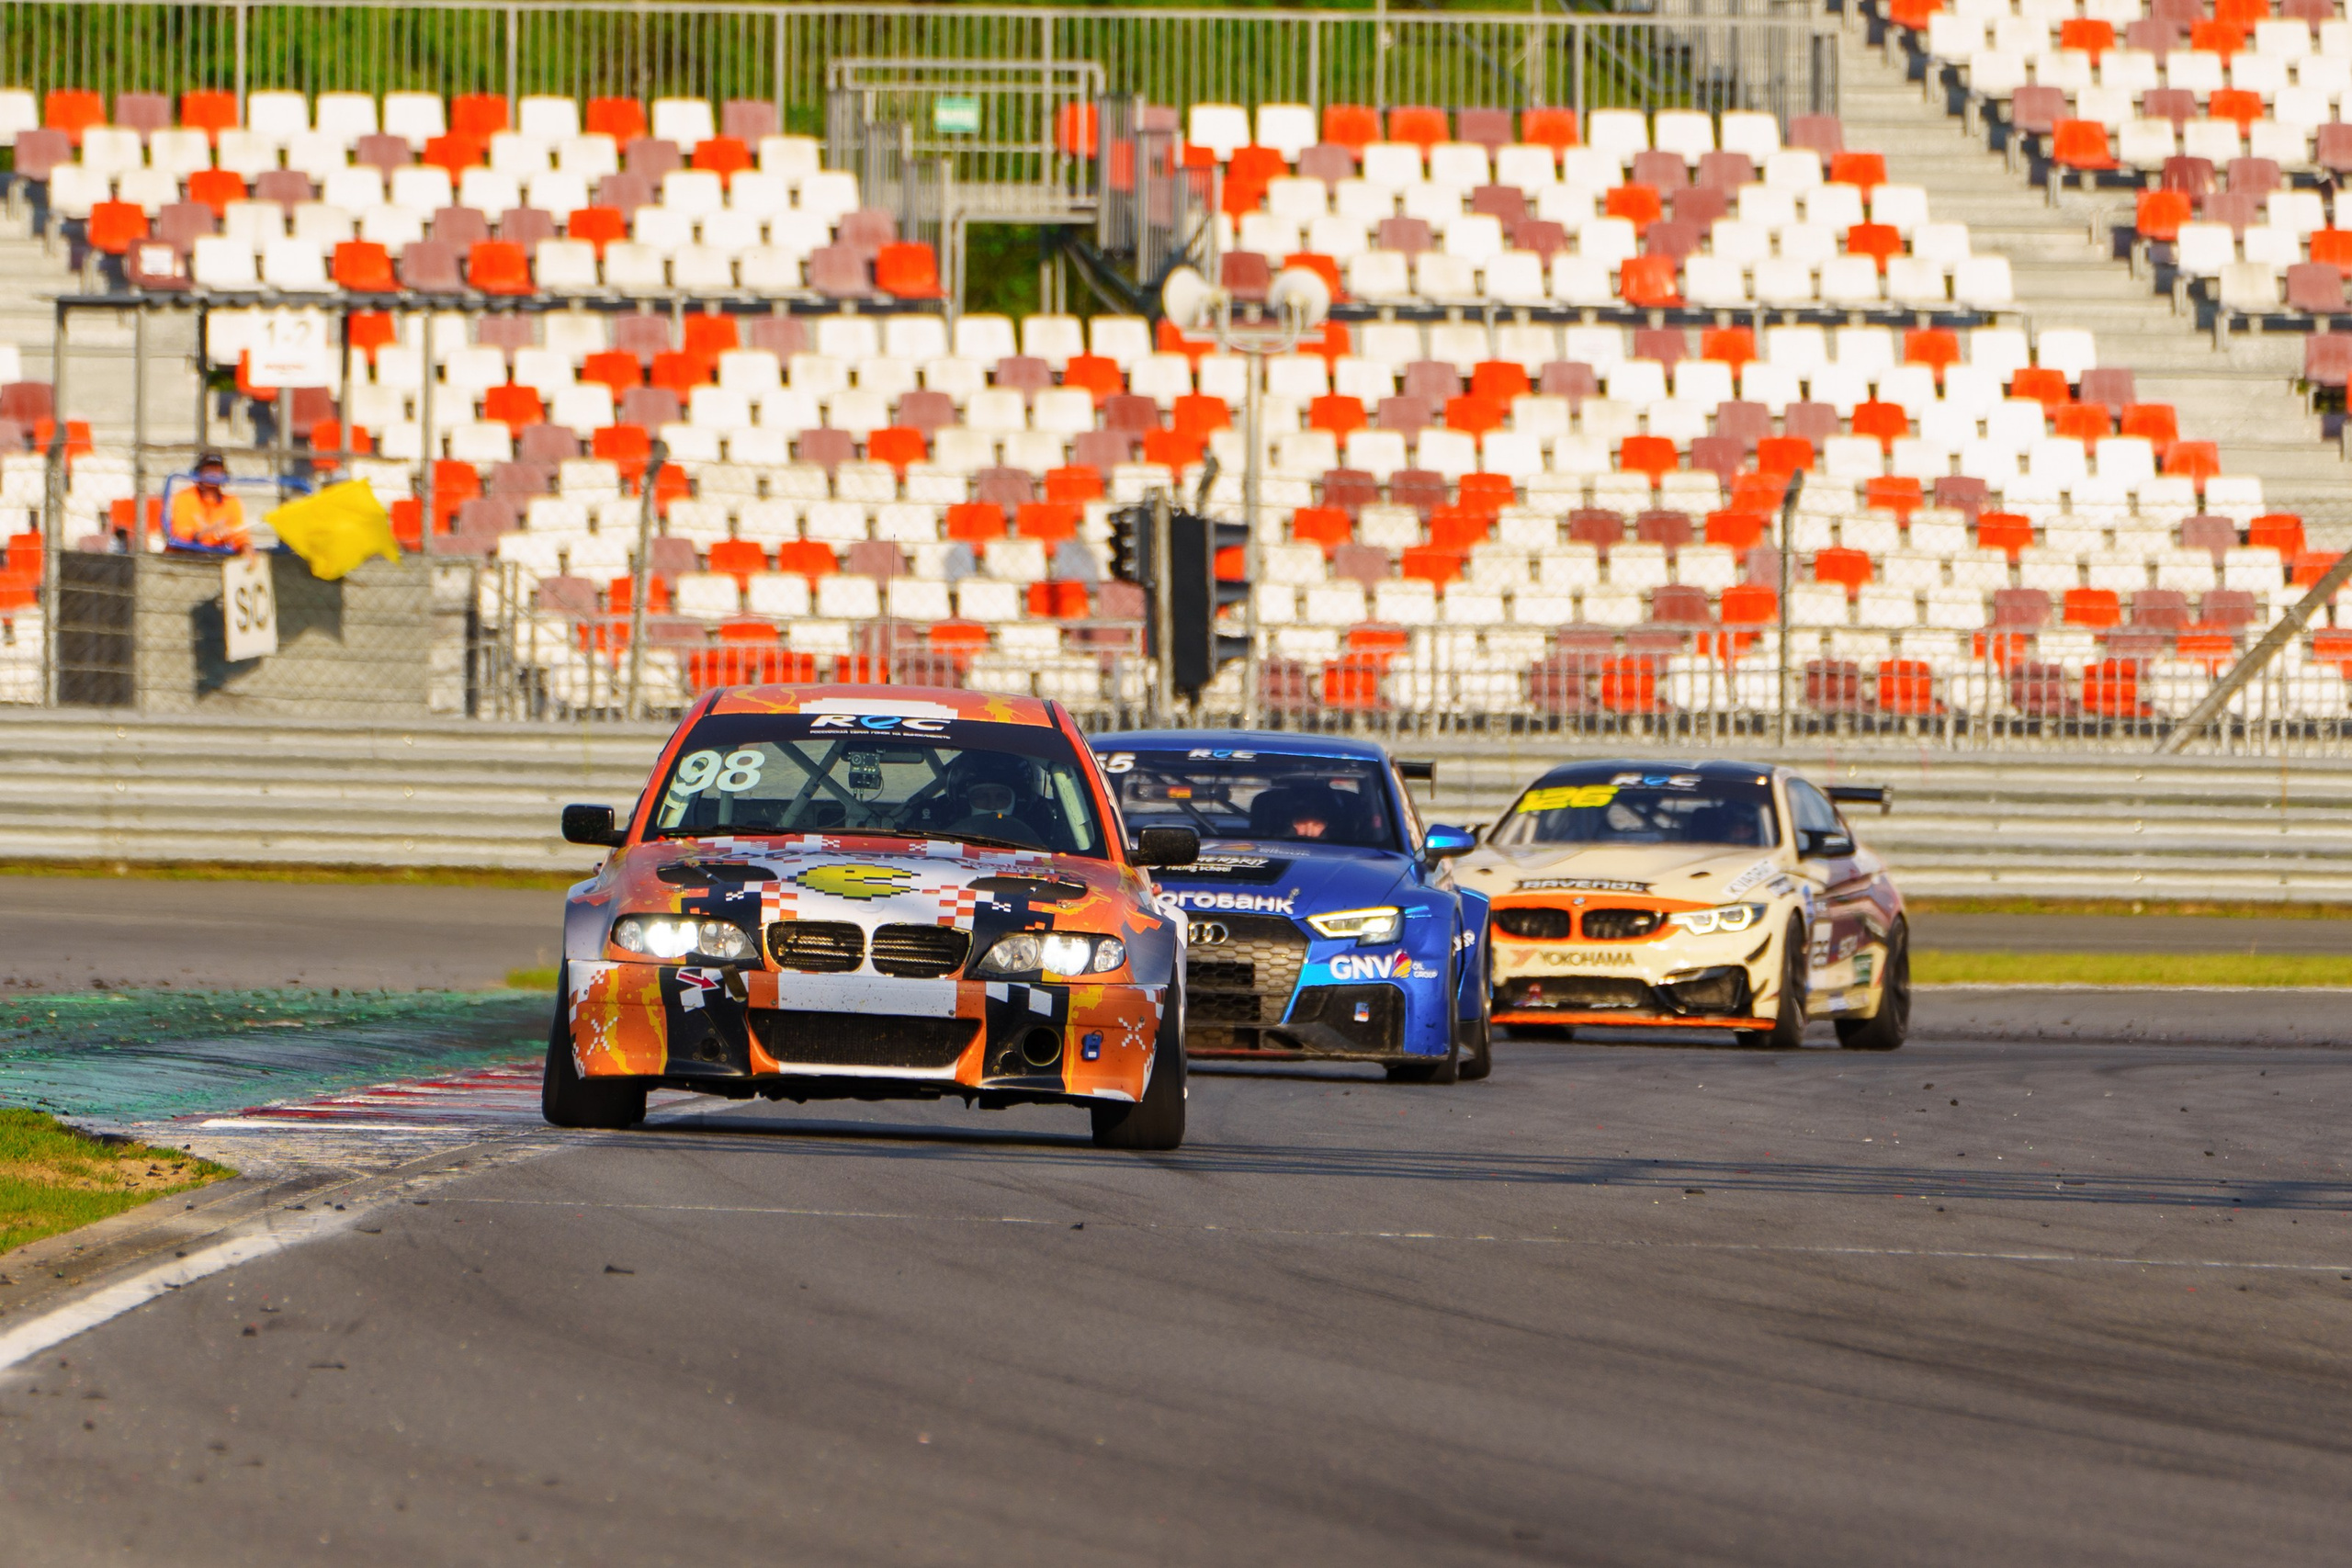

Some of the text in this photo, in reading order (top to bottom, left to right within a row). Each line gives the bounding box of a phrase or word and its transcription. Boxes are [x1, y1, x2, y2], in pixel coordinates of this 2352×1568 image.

[235, 581, 268, 634] SC
[671, 750, 765, 796] 98
[1166, 864, 1198, 873] racing
[1329, 953, 1394, 980] GNV
[1539, 951, 1635, 966] YOKOHAMA
